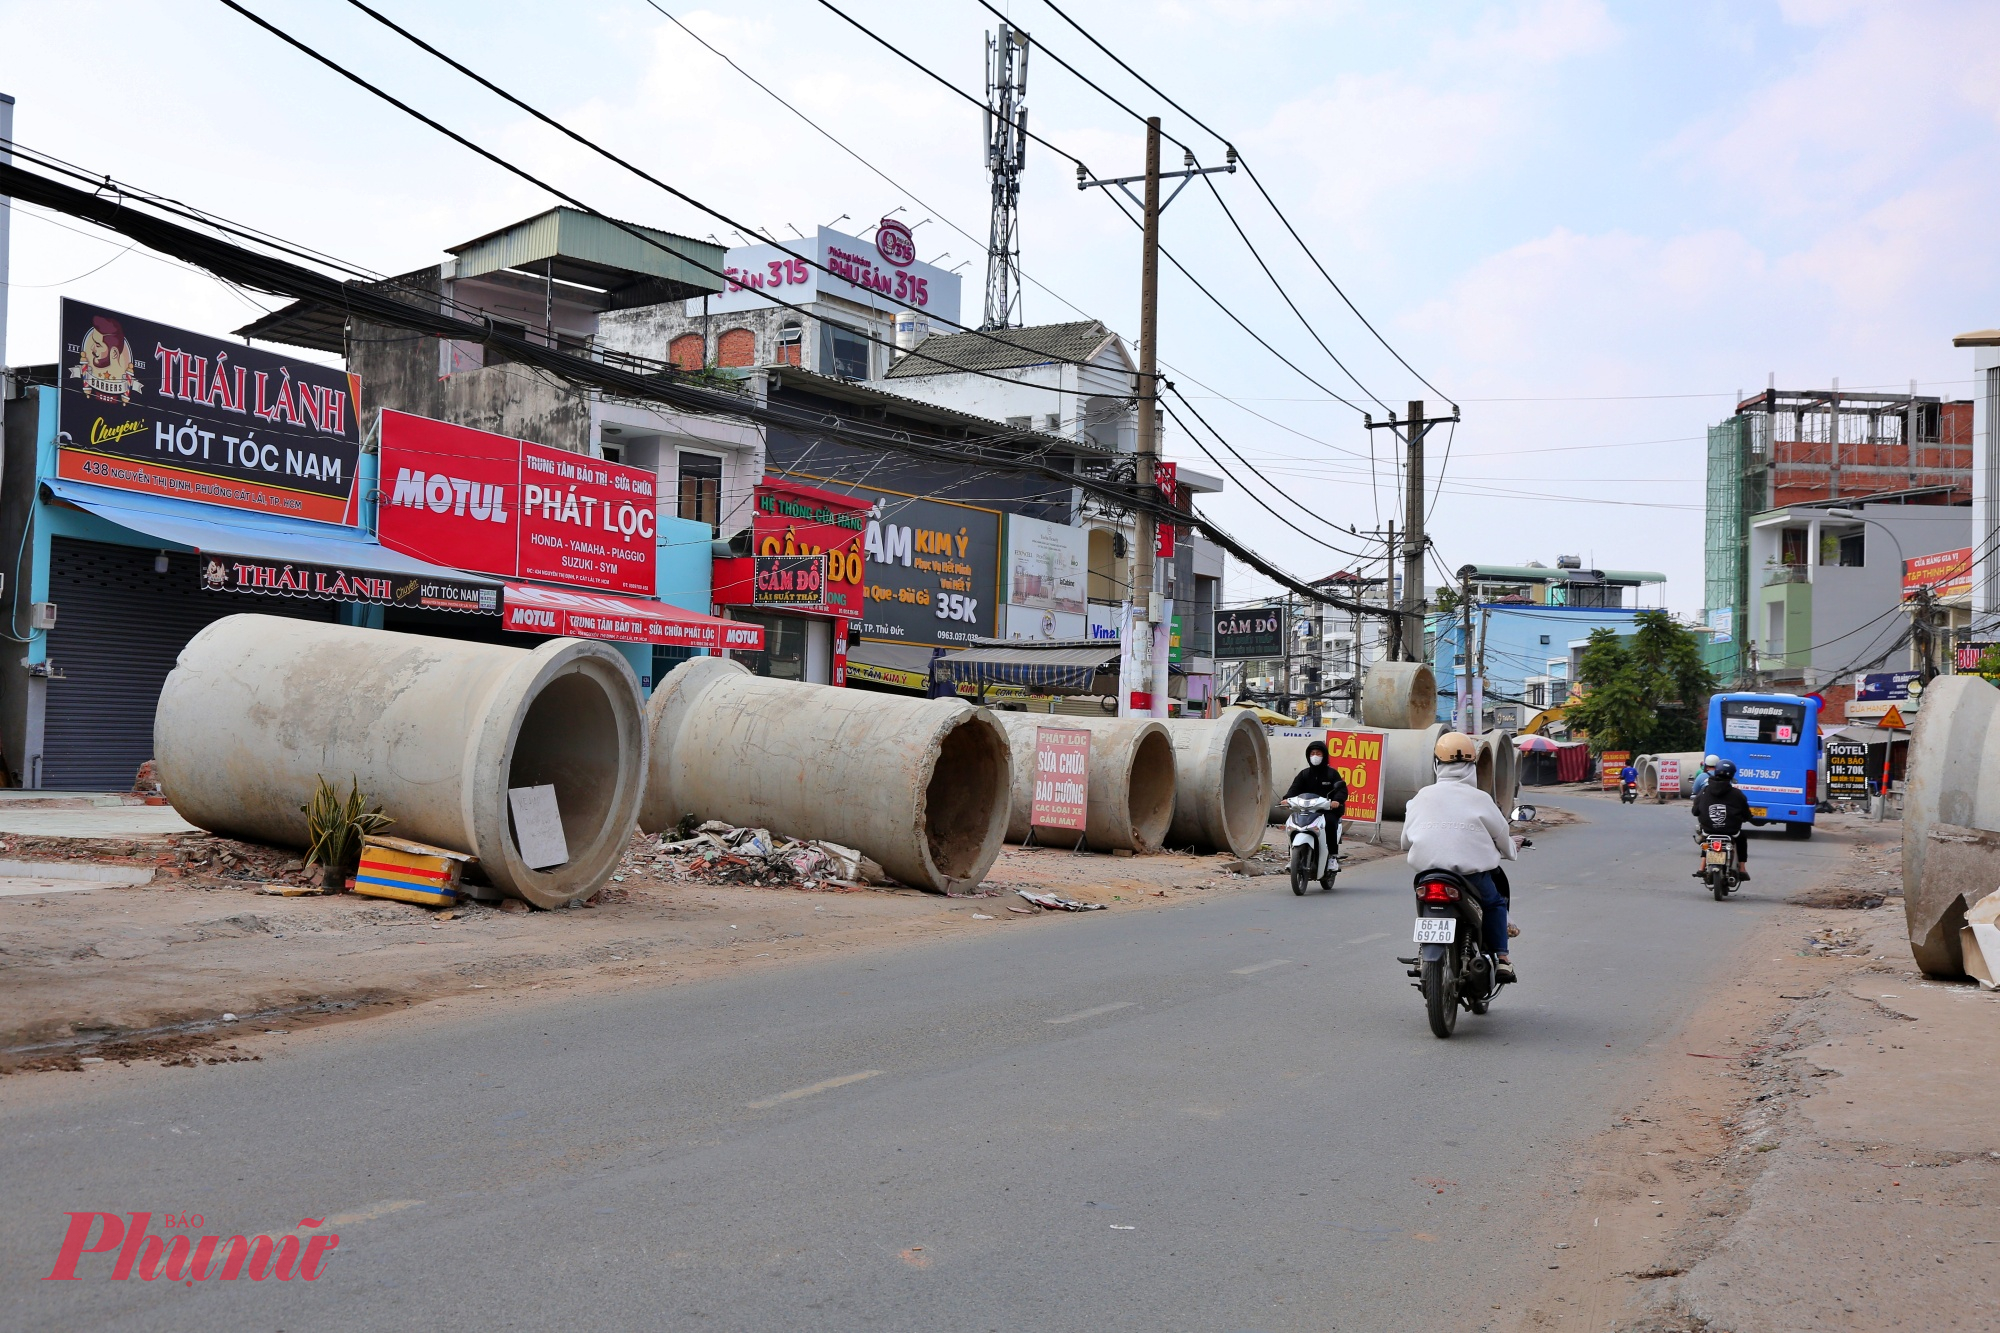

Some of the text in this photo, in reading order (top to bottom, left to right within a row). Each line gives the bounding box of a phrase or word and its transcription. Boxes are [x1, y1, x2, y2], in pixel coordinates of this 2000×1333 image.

[767, 258, 809, 287] 315
[828, 258, 928, 306] PHỤ SẢN 315
[92, 378, 122, 392] BARBERS
[155, 342, 346, 436] THÁI LÀNH
[155, 418, 342, 484] HỚT TÓC NAM
[82, 460, 109, 476] 438
[152, 475, 167, 490] THỊ
[195, 482, 232, 498] PHƯỜNG
[233, 486, 251, 501] CÁT
[284, 498, 302, 510] HCM
[526, 454, 652, 496] TRUNG TÂM BẢO TRÌ SỬA CHỮA
[392, 467, 508, 524] MOTUL
[760, 494, 775, 514] HỆ
[778, 498, 812, 520] THỐNG
[524, 484, 654, 543] PHÁT LỘC
[864, 497, 968, 568] ẤM KIM Ý
[531, 532, 645, 563] HONDA YAMAHA PIAGGIO
[562, 555, 618, 574] SUZUKI SYM
[828, 538, 862, 585] ĐỒ
[932, 560, 942, 576] Vụ
[1914, 552, 1958, 568] CỬA HÀNG GIA VỊ
[233, 562, 310, 592] THÁI
[315, 570, 392, 599] LÀNH
[421, 582, 440, 598] HỚT
[441, 584, 458, 600] TÓC
[460, 588, 478, 602] NAM
[758, 560, 820, 591] CẦM ĐỒ
[1907, 572, 1922, 581] T&P
[1922, 567, 1944, 580] THỊNH
[758, 590, 819, 600] LÃI SUẤT THẤP
[826, 592, 847, 606] ONG
[871, 585, 892, 602] Que
[898, 587, 916, 605] Đùi
[916, 588, 930, 606] Gà
[936, 592, 978, 624] 35K
[511, 608, 556, 628] MOTUL
[570, 615, 596, 629] TRUNG
[598, 617, 614, 630] TÂM
[614, 618, 630, 633] BẢO
[630, 620, 642, 634] TRÌ
[648, 620, 663, 636] SỬA
[664, 623, 684, 638] CHỮA
[684, 624, 701, 639] PHÁT
[702, 628, 715, 640] LỘC
[726, 629, 758, 644] MOTUL
[864, 624, 904, 636] TP. Thủ Đức
[1218, 610, 1278, 634] CẦM ĐỒ
[1958, 644, 1980, 669] BÚN
[864, 666, 882, 680] TẤM
[884, 672, 900, 684] KIM
[902, 674, 908, 684] Ý
[960, 684, 976, 694] KIM
[996, 688, 1014, 697] CƠM
[1742, 706, 1784, 716] SaigonBus
[1039, 732, 1066, 745] PHÁT
[1779, 728, 1790, 738] 43
[1328, 732, 1380, 760] CẦM
[1830, 746, 1864, 754] HOTEL
[1038, 745, 1085, 774] SỬA CHỮA
[1831, 766, 1864, 774] 1H: 70K
[1338, 762, 1366, 788] ĐỒ
[1738, 768, 1781, 780] 50H-798.97
[1036, 774, 1084, 804] BẢO DƯỠNG
[1052, 804, 1070, 815] LOẠI
[1418, 930, 1452, 942] 697.60
[1422, 920, 1449, 930] 66-AA
